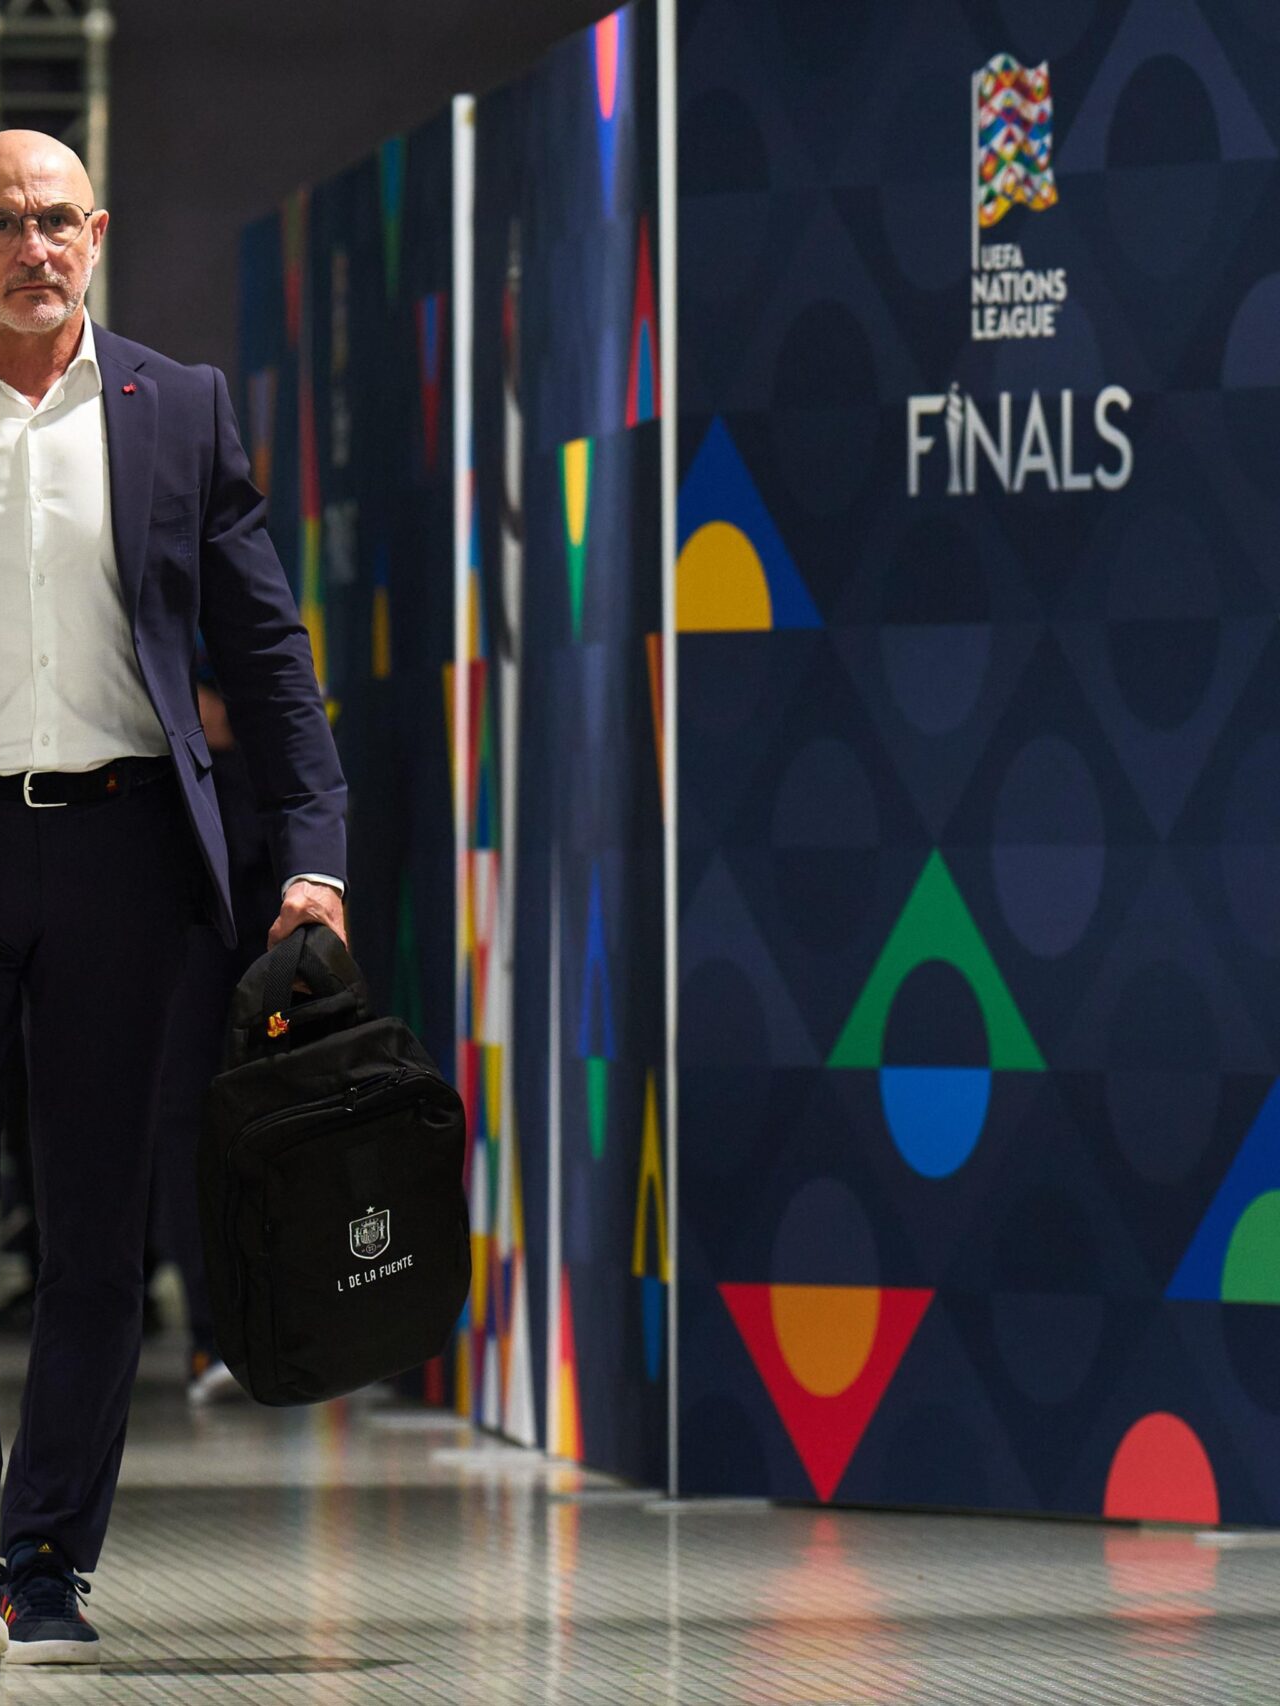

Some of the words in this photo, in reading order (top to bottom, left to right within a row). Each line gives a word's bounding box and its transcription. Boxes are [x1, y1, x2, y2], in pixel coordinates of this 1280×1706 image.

[980, 243, 1024, 270] UEFA
[971, 269, 1068, 304] NATIONS
[971, 303, 1056, 341] LEAGUE
[907, 382, 1133, 496] FINALS
[337, 1280, 344, 1292] L
[348, 1273, 362, 1288] DE
[364, 1269, 377, 1283] LA
[378, 1254, 414, 1278] FUENTE
